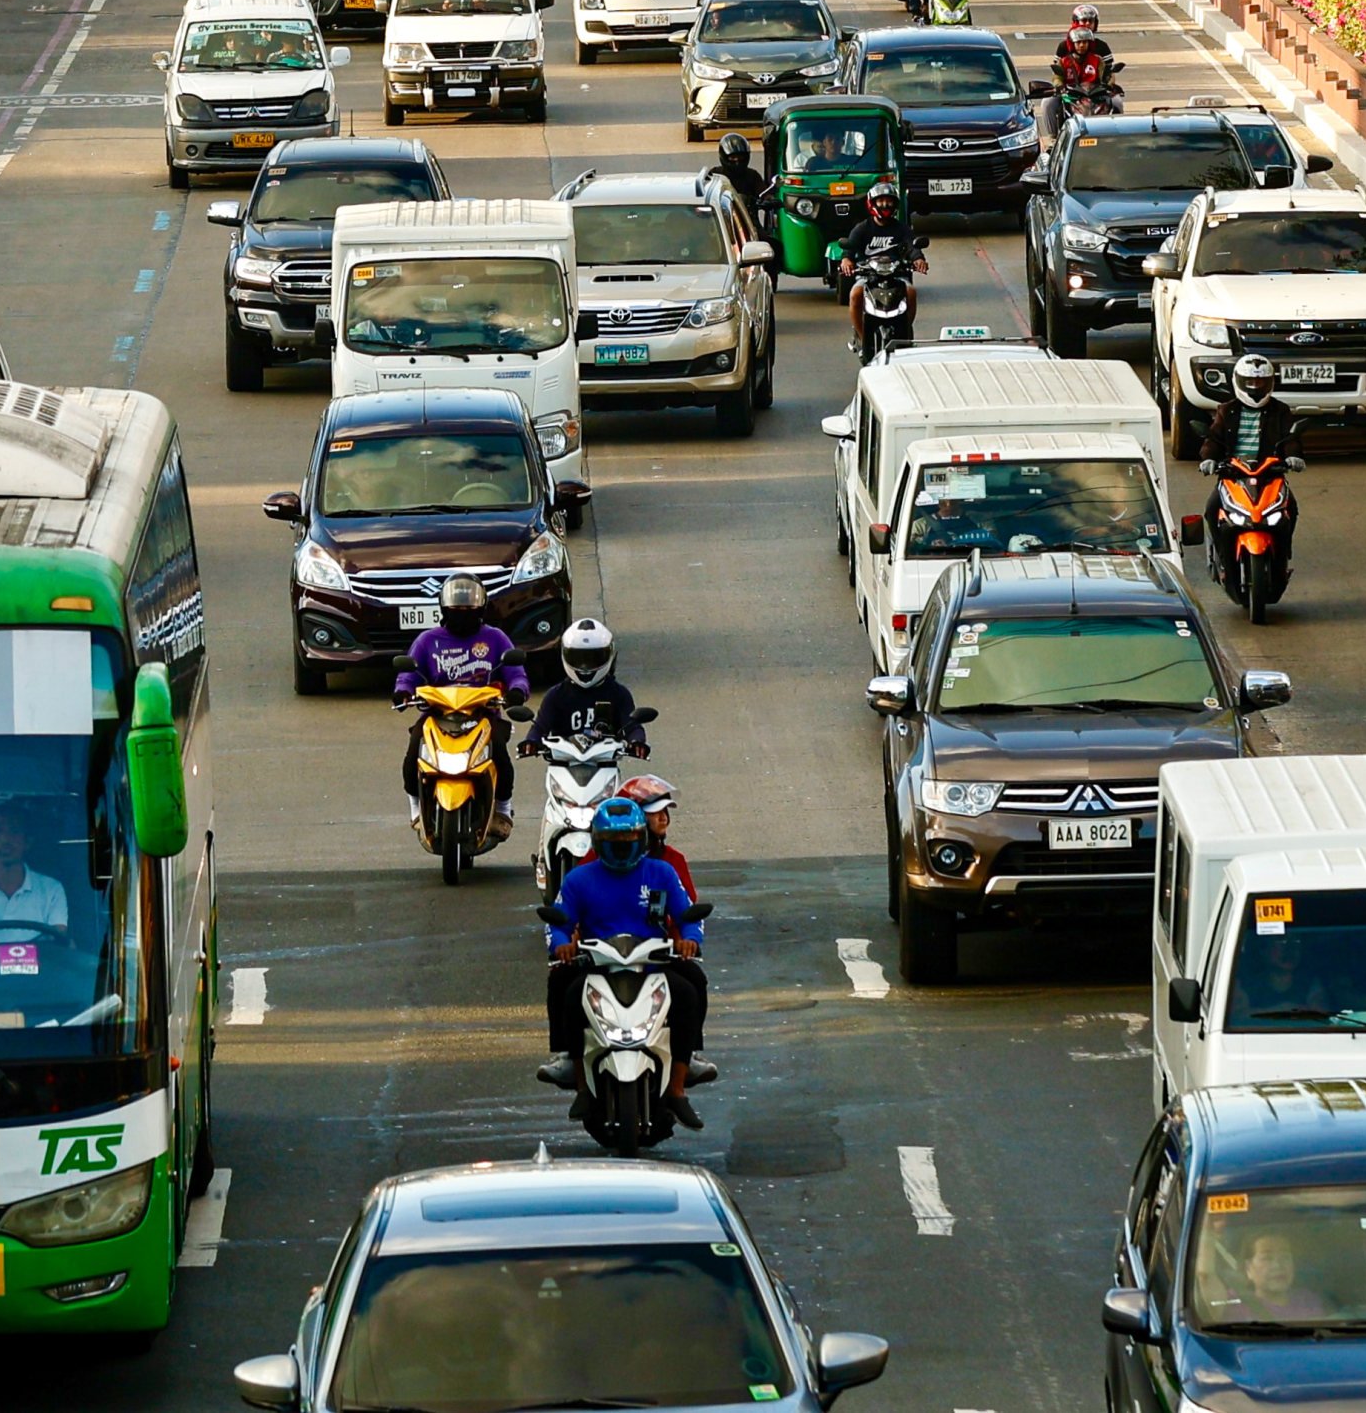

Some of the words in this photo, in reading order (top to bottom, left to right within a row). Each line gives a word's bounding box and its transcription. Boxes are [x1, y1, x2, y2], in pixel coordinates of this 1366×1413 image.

[950, 181, 971, 191] 1723
[1146, 226, 1179, 236] ISUZ
[869, 236, 895, 248] NIKE
[380, 372, 423, 380] TRAVIZ
[1306, 367, 1333, 380] 5422
[432, 649, 470, 674] National
[447, 659, 493, 682] Champions
[571, 707, 595, 732] GA
[1056, 825, 1083, 842] AAA
[1089, 823, 1128, 841] 8022
[38, 1123, 126, 1176] TAS
